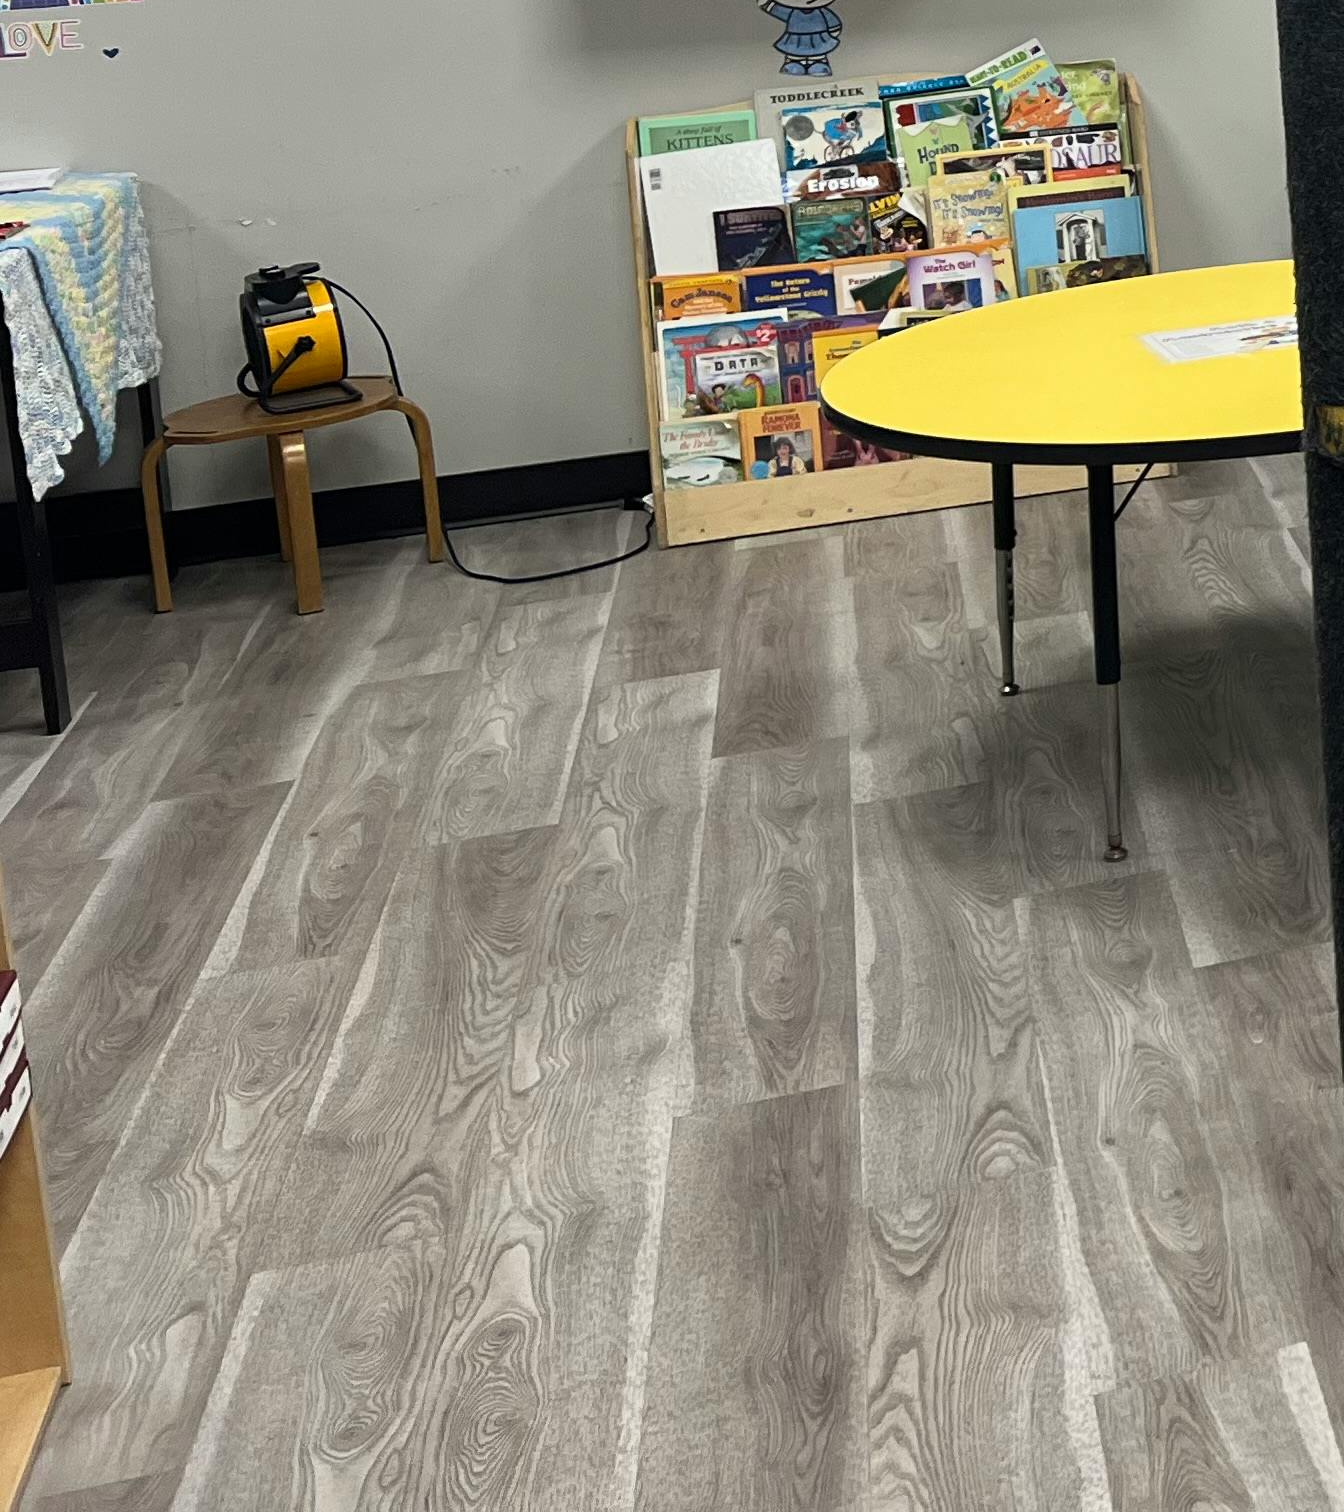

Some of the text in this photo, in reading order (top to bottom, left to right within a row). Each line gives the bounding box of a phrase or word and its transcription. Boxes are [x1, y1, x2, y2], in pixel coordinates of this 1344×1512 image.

[0, 19, 82, 59] LOVE
[769, 87, 865, 104] TODDLECREEK
[666, 133, 735, 151] KITTENS
[807, 175, 880, 193] Erosion
[923, 259, 976, 273] Watch Girl
[714, 357, 758, 371] DATA
[761, 413, 801, 425] RAMONA
[762, 422, 802, 432] FOREVER
